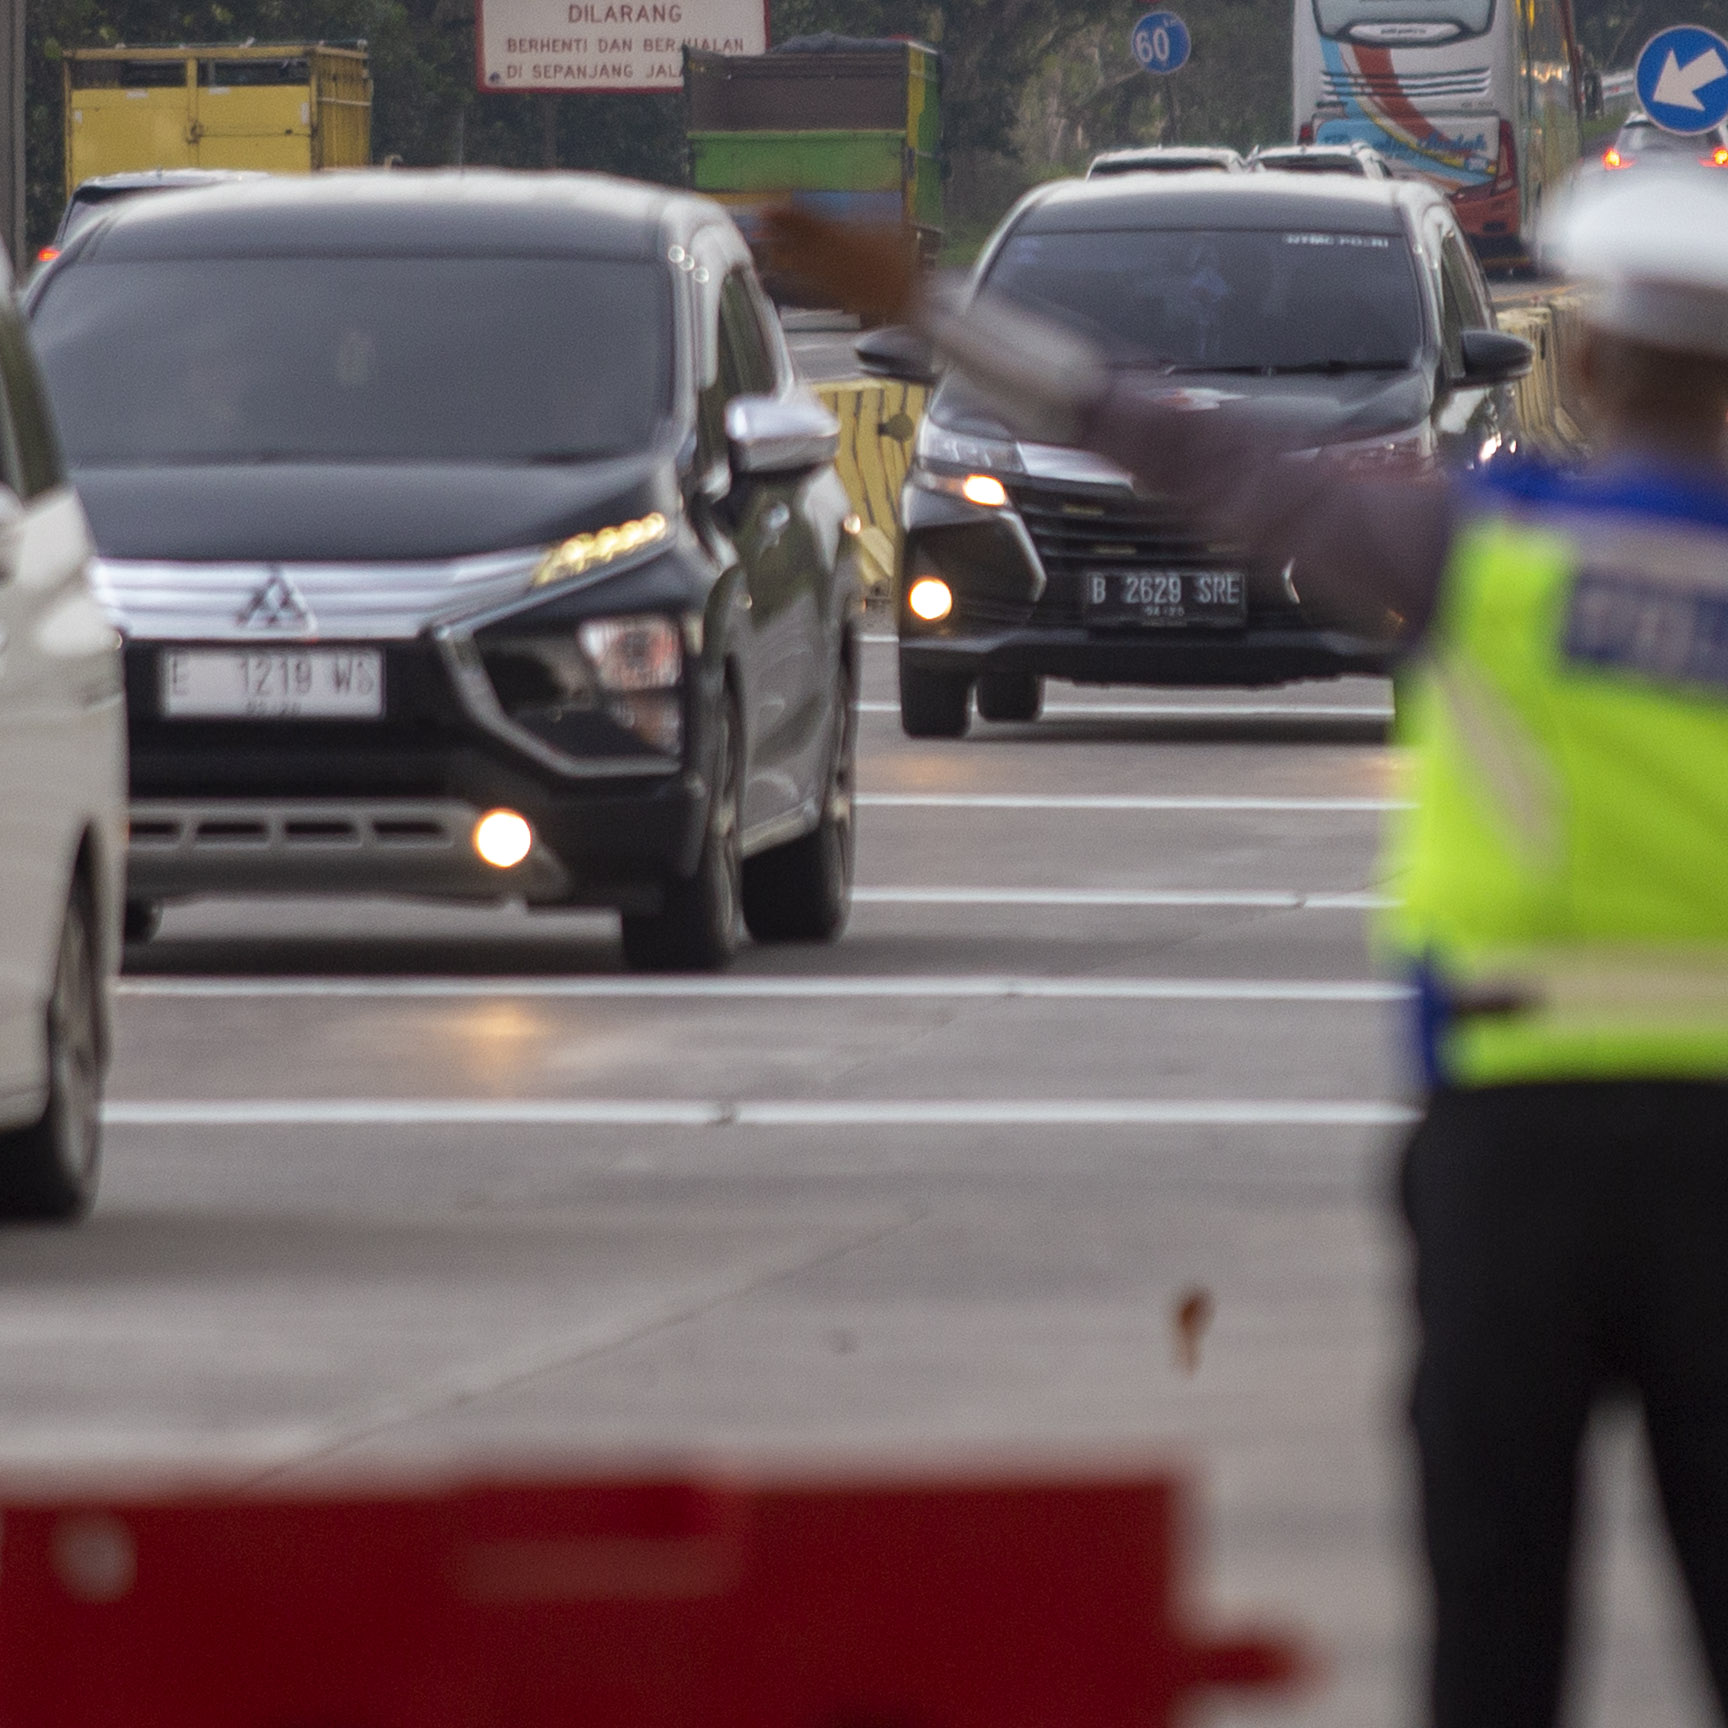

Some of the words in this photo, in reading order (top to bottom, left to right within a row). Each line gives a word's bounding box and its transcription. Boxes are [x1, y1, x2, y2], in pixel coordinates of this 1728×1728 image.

[568, 3, 683, 24] DILARANG
[507, 38, 588, 54] BERHENTI
[598, 38, 633, 54] DAN
[1135, 26, 1170, 63] 60
[506, 65, 524, 80] DI
[533, 64, 634, 81] SEPANJANG
[1092, 576, 1106, 604] B
[1126, 576, 1182, 604] 2629
[1199, 574, 1241, 604] SRE
